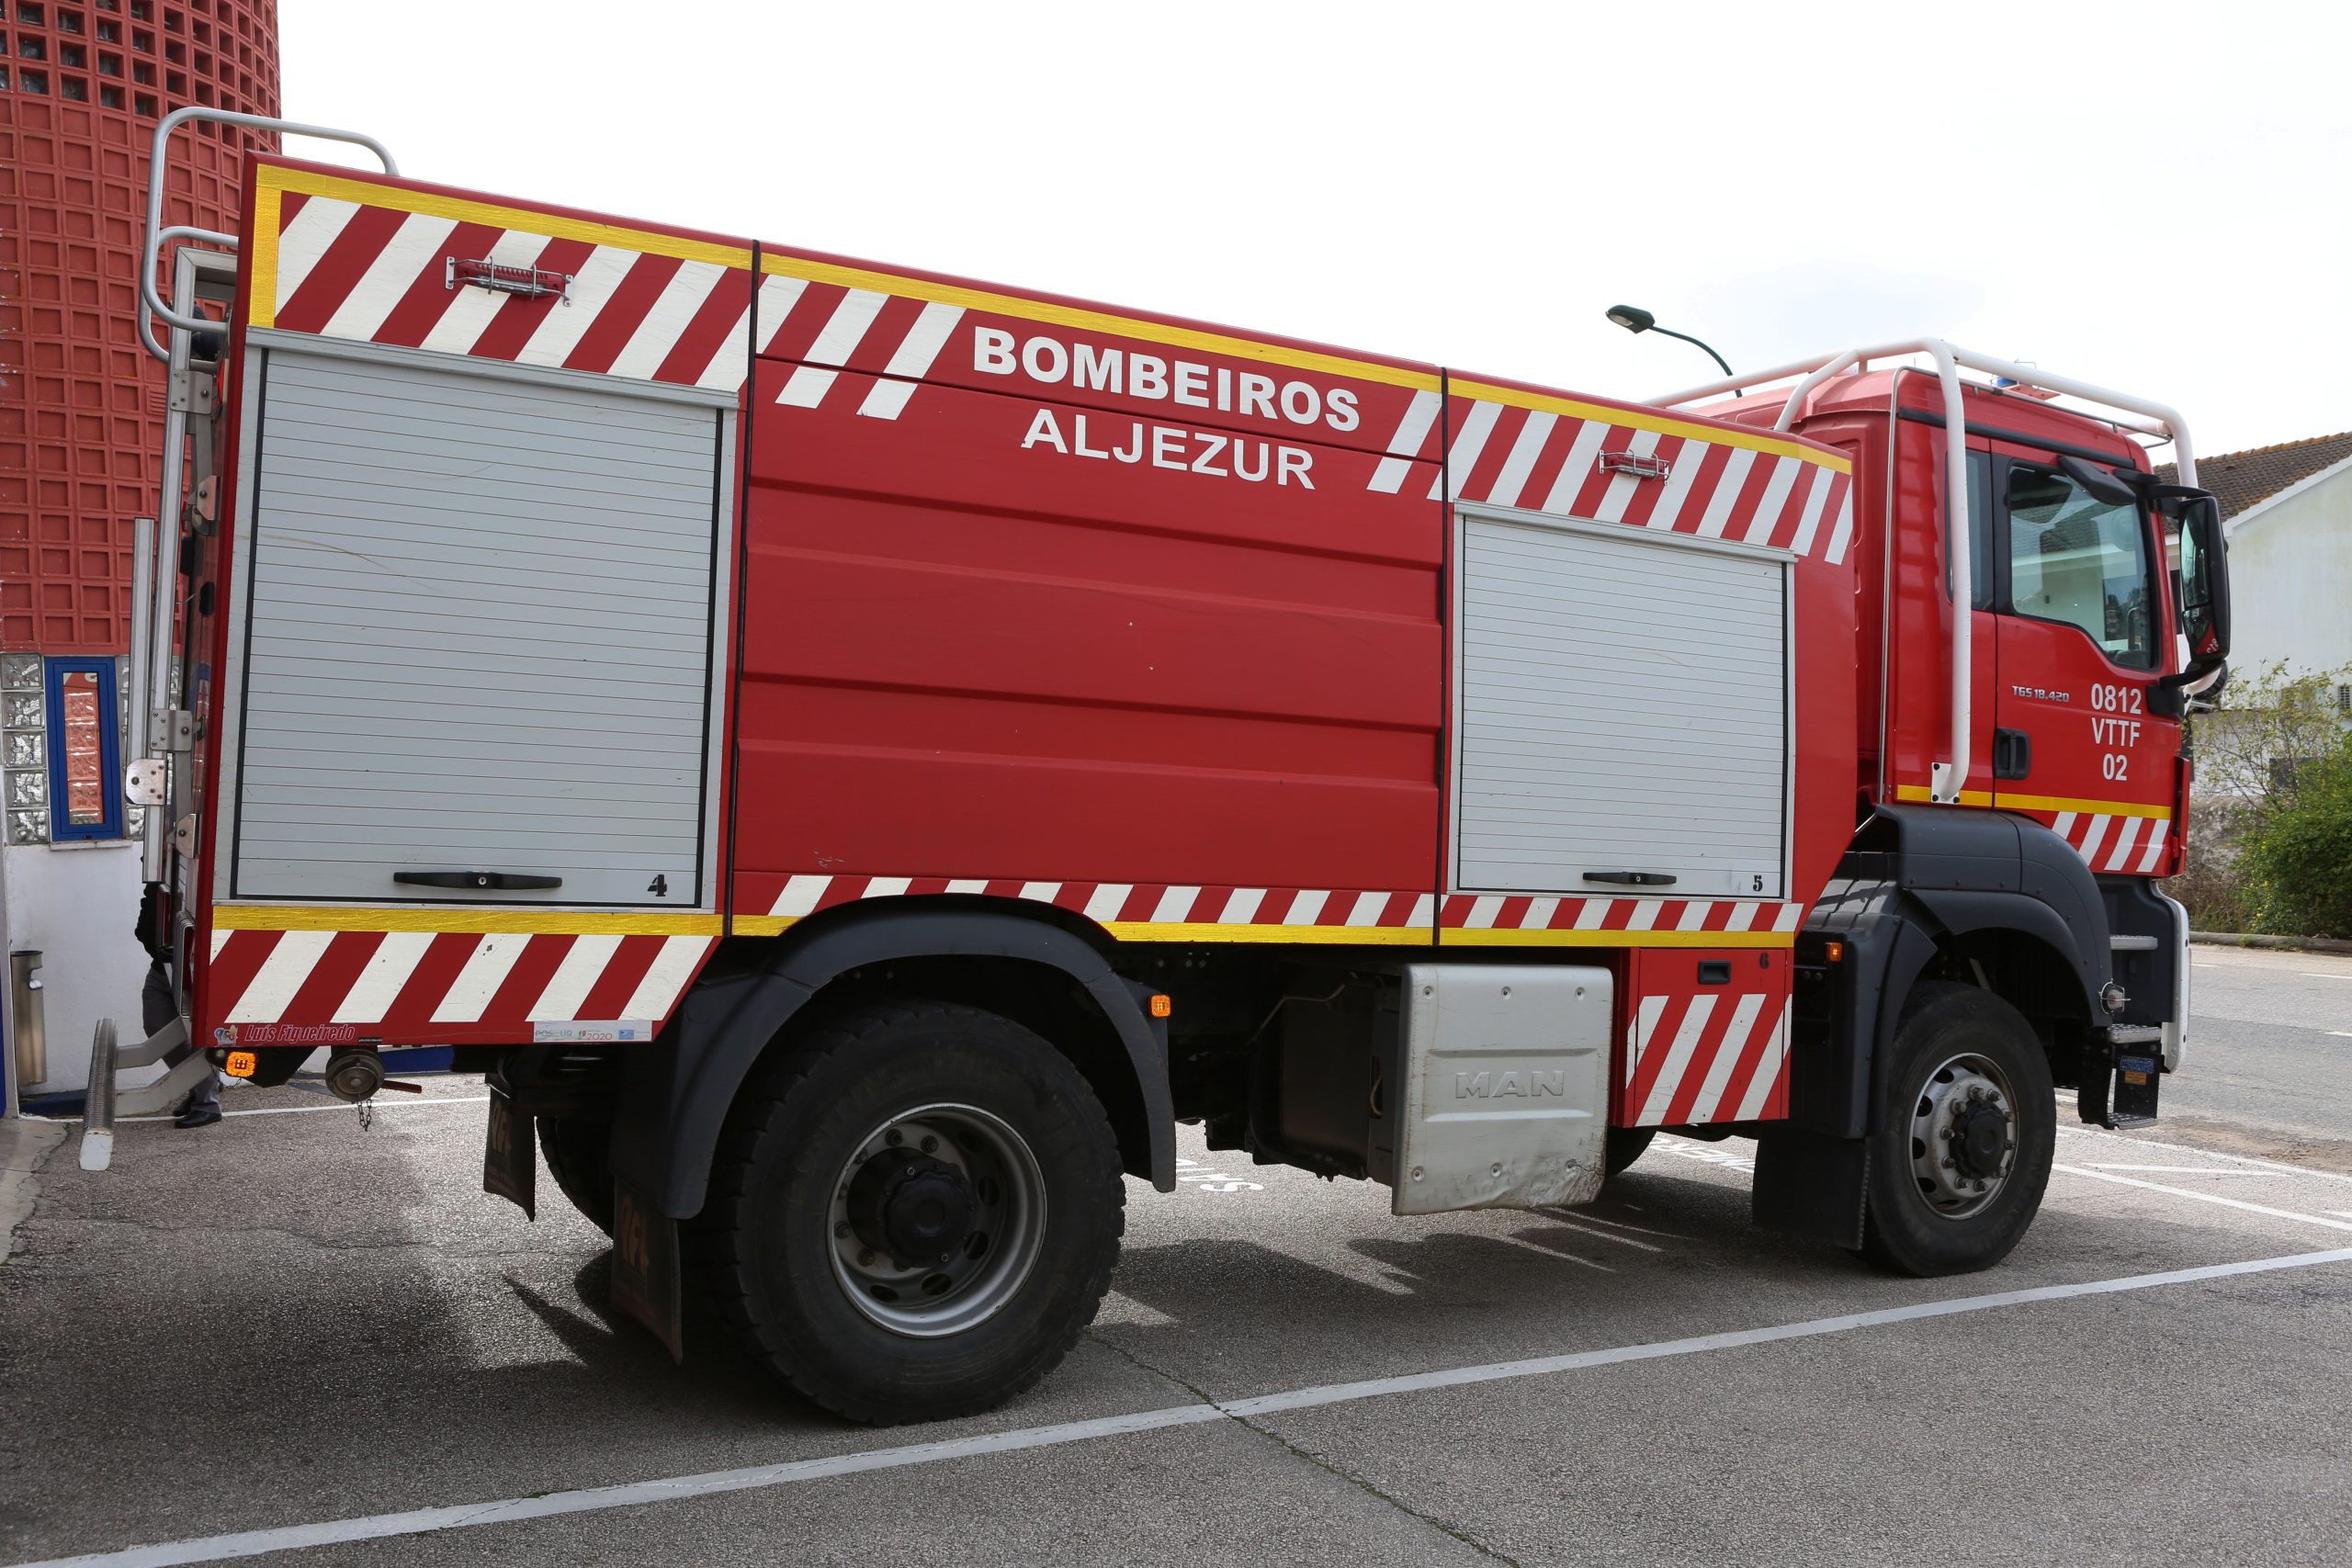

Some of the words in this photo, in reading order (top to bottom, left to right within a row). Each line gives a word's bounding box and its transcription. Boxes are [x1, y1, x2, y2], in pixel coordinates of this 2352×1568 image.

[974, 326, 1360, 432] BOMBEIROS
[1021, 409, 1316, 491] ALJEZUR
[2011, 685, 2032, 698] TGS
[2034, 689, 2070, 703] 18.420
[2091, 682, 2142, 715] 0812
[2091, 717, 2142, 748] VTTF
[2103, 753, 2128, 781] 02
[647, 874, 668, 897] 4
[1753, 874, 1763, 892] 5
[1759, 952, 1770, 970] 6
[277, 1023, 356, 1044] Figueiredo
[586, 1032, 613, 1041] 2020
[1454, 1070, 1566, 1100] MAN
